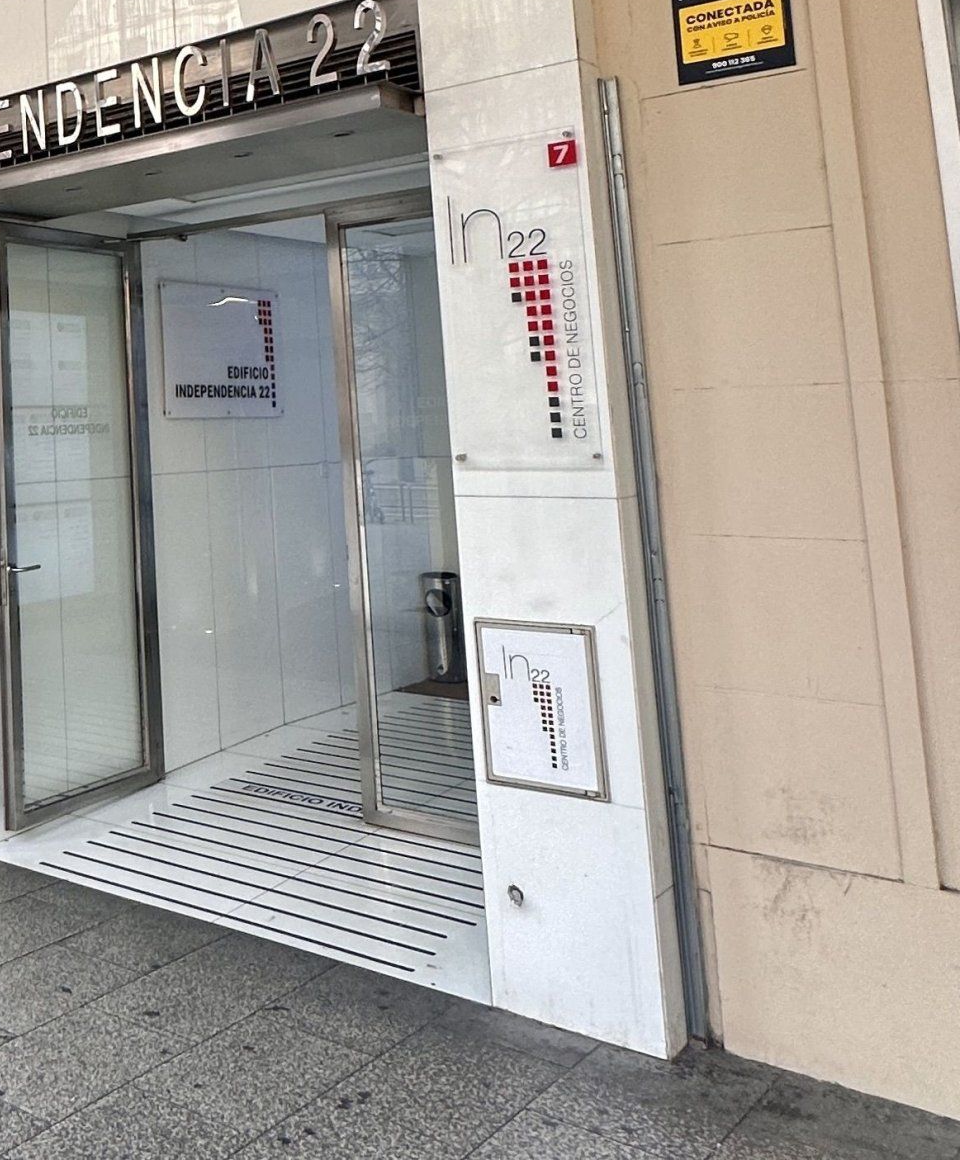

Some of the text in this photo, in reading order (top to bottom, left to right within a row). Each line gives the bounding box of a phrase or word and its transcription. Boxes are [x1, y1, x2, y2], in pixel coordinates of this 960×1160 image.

[686, 0, 775, 25] CONECTADA
[687, 24, 705, 33] CON
[706, 17, 732, 29] AVISO
[741, 9, 775, 22] POLICÍA
[306, 0, 390, 88] 22
[552, 144, 569, 165] 7
[559, 259, 587, 440] CENTRO DE NEGOCIOS
[227, 366, 269, 379] EDIFICIO
[175, 384, 270, 398] INDEPENDENCIA 22
[555, 687, 569, 771] CENTRO DE NEGOCIOS
[241, 784, 323, 806] EDIFICIO
